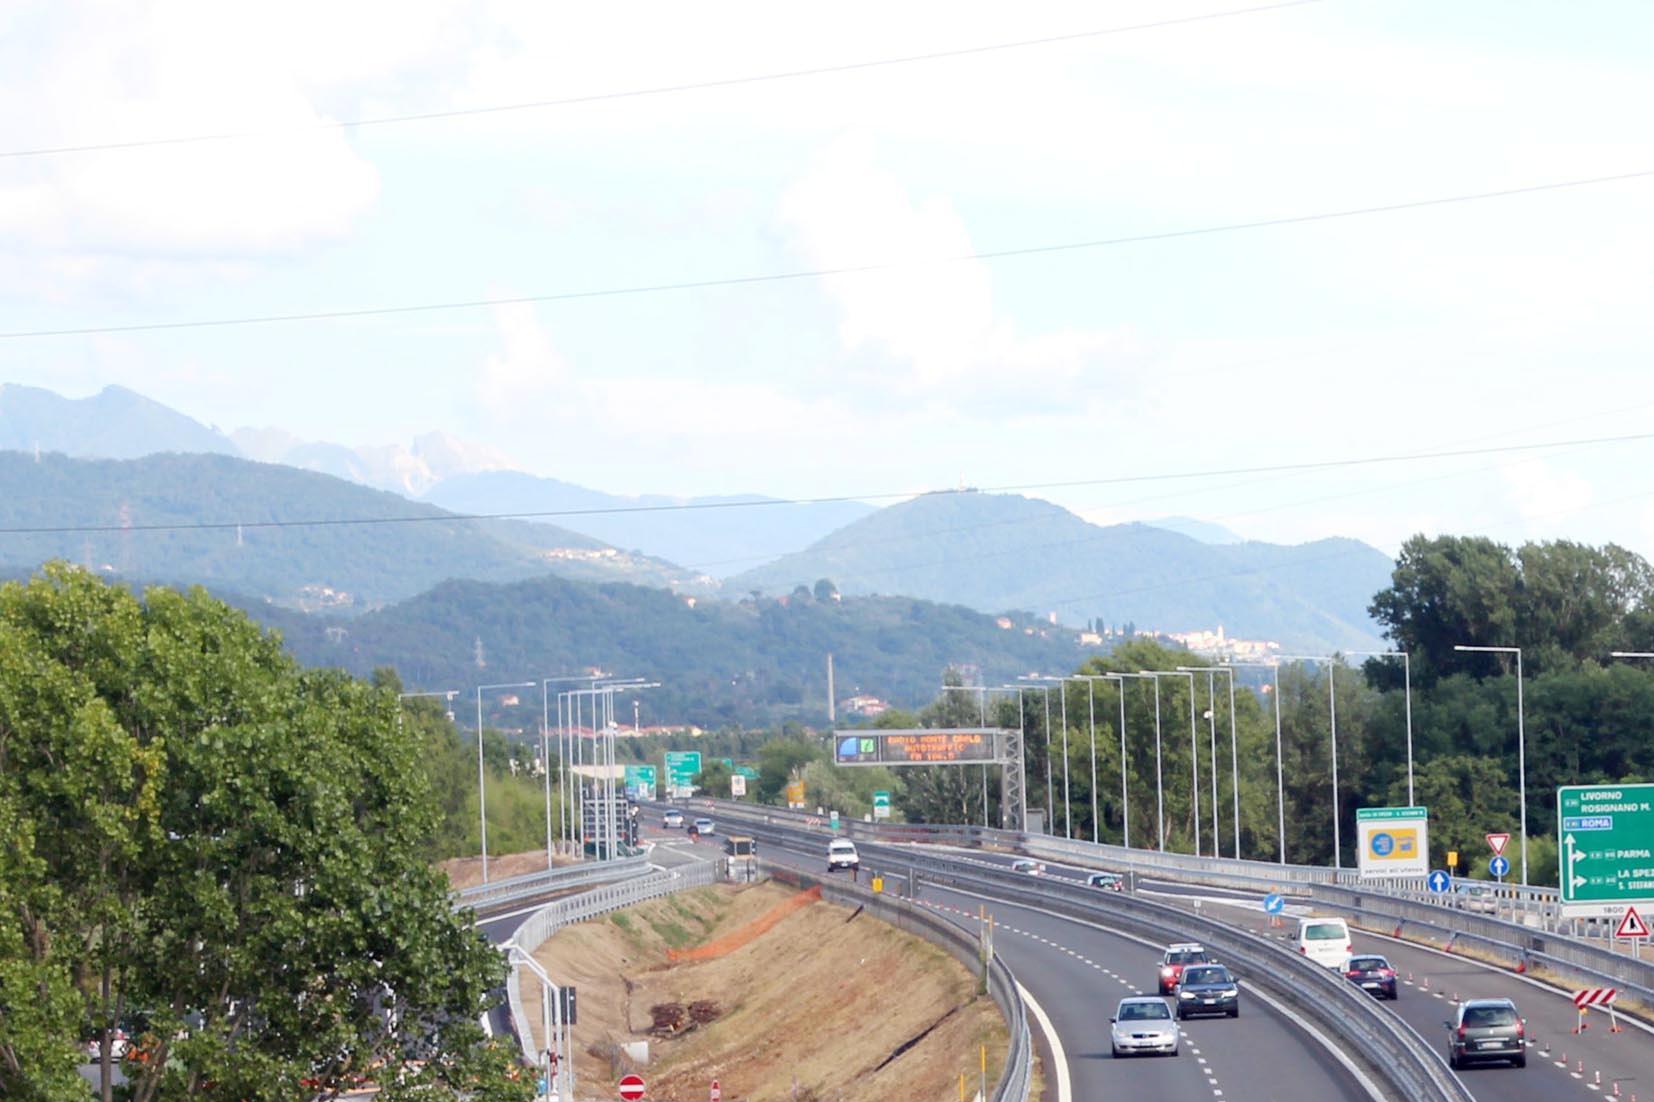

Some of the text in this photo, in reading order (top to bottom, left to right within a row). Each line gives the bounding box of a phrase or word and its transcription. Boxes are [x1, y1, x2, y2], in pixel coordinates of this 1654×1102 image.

[1580, 791, 1622, 801] LIVORNO
[1581, 803, 1638, 813] ROSIGNANO
[1581, 819, 1609, 828] ROMA
[1617, 849, 1650, 859] PARMA
[1617, 870, 1630, 878] LA
[1603, 906, 1625, 914] 1800
